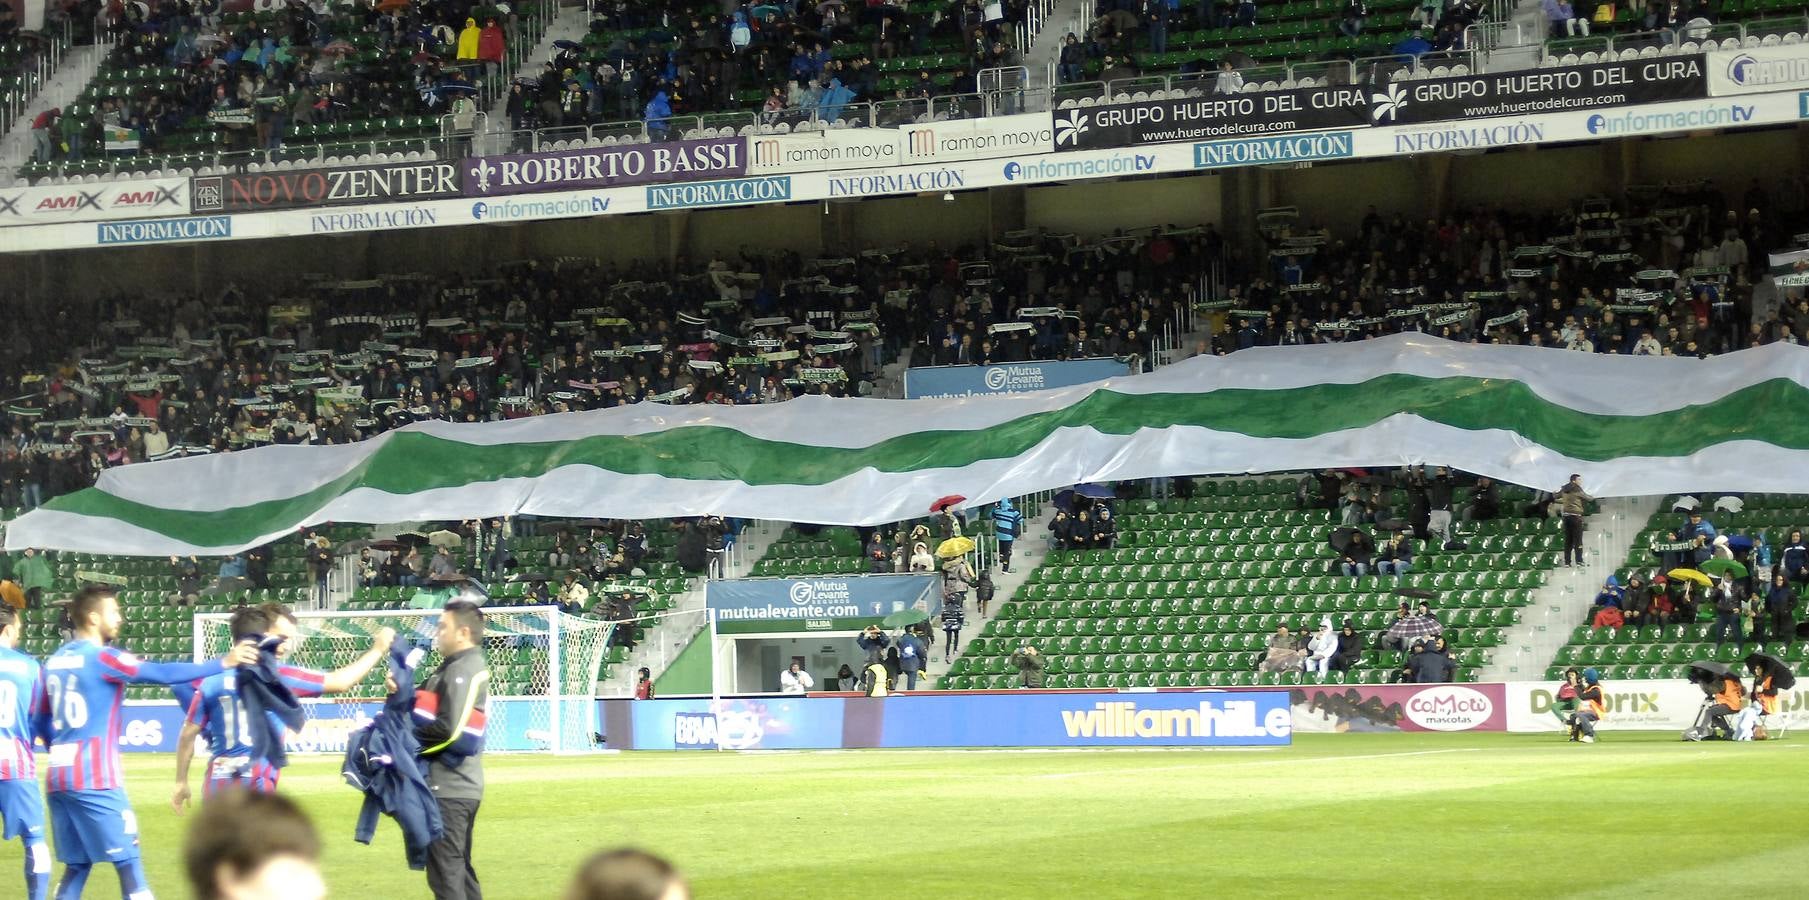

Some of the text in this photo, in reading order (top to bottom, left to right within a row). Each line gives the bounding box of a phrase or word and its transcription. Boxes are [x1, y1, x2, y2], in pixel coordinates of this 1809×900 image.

[1415, 60, 1701, 103] GRUPO HUERTO DEL CURA
[1743, 56, 1809, 87] RADIO
[1096, 89, 1366, 128] GRUPO HUERTO DEL CURA
[1463, 92, 1626, 117] www.huertodelcura.com
[940, 135, 999, 151] ramon
[1002, 128, 1051, 150] moya
[1142, 119, 1296, 142] www.huertodelcura.com
[1394, 120, 1544, 152] INFORMACIÓN
[786, 142, 894, 162] ramon moya
[1199, 132, 1348, 165] INFORMACIÓN
[501, 143, 739, 187] ROBERTO BASSI
[199, 185, 219, 196] ZEN
[651, 176, 788, 208] INFORMACIÓN
[828, 167, 964, 196] INFORMACIÓN
[36, 187, 109, 214] AMIX
[114, 183, 186, 208] AMIX
[200, 195, 220, 206] TER
[102, 217, 228, 242] INFORMACIÓN
[311, 207, 437, 233] INFORMACIÓN
[1006, 374, 1044, 384] Levante
[1008, 366, 1042, 376] Mutua
[812, 591, 849, 600] Levante
[813, 581, 848, 591] Mutua
[720, 604, 859, 619] mutualevante.com
[807, 620, 831, 628] SALIDA
[46, 672, 88, 730] 26
[1426, 716, 1472, 725] mascotas
